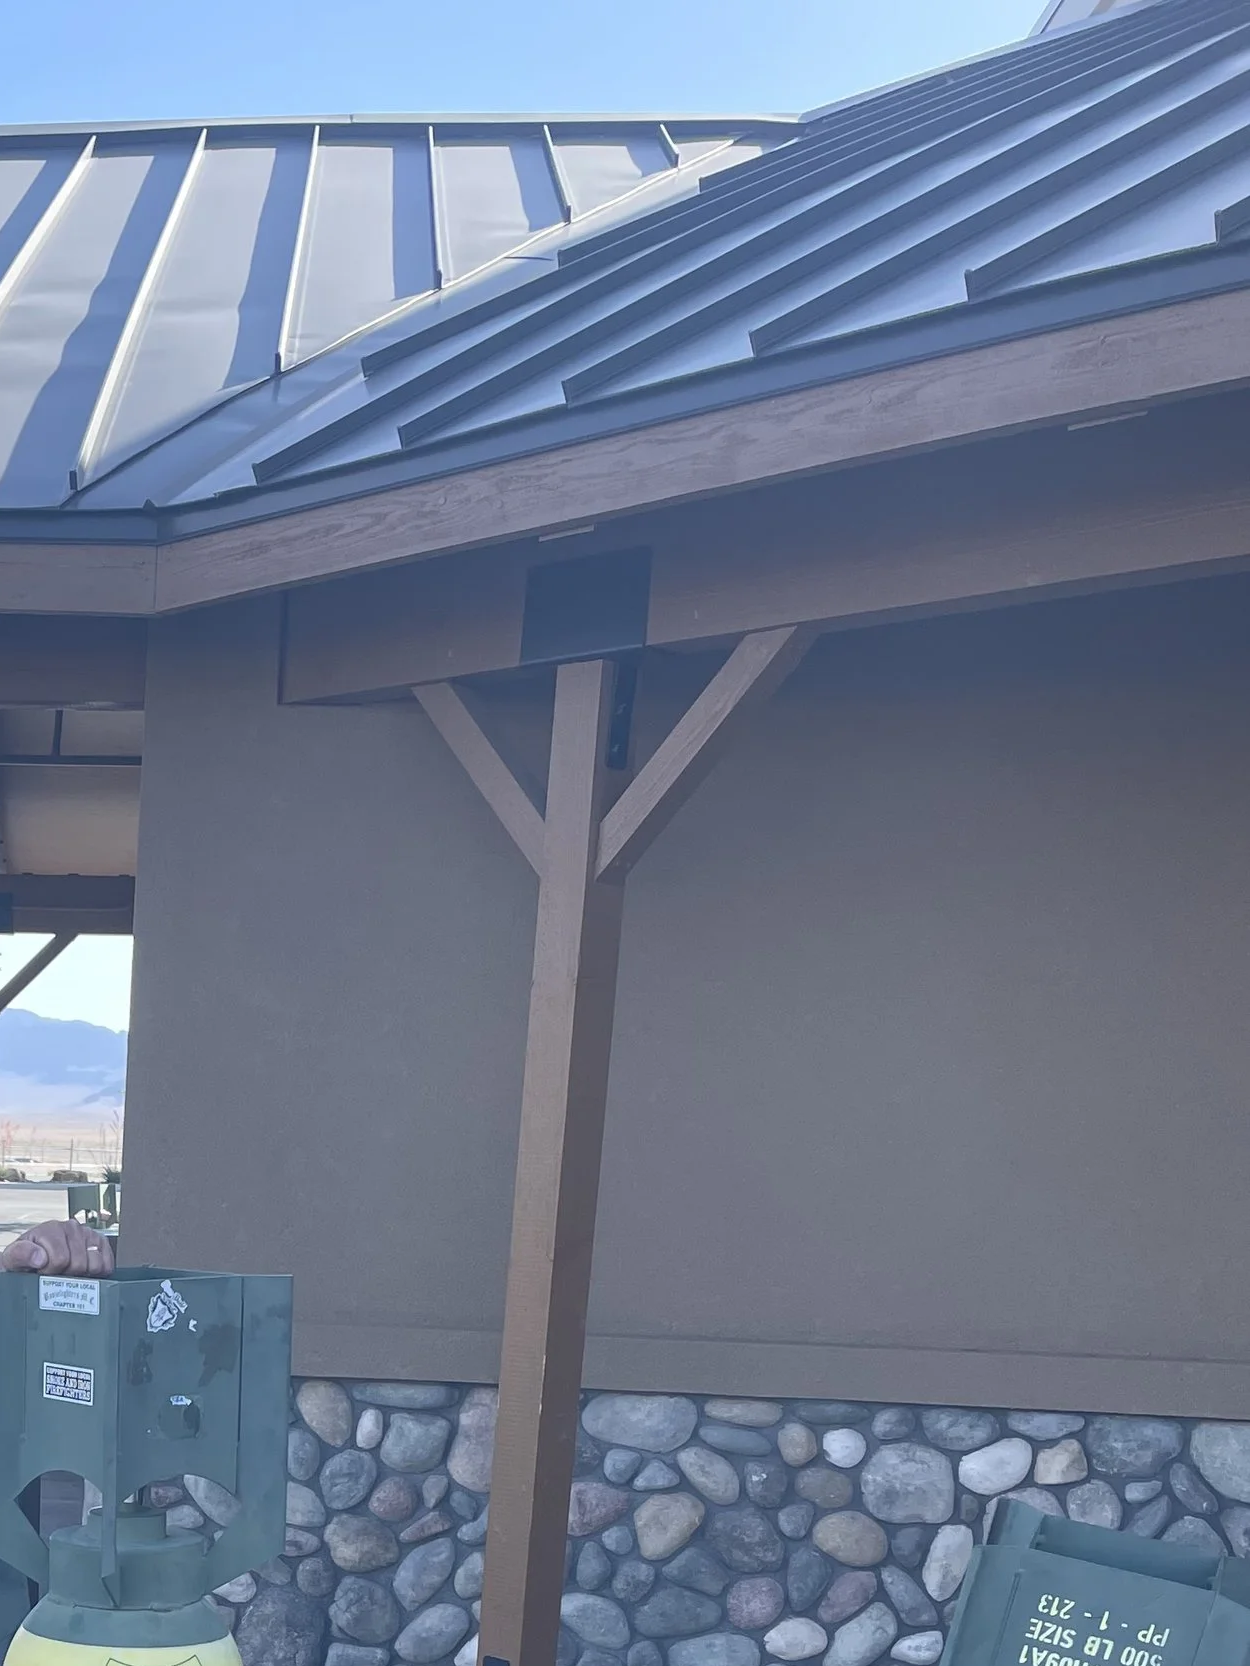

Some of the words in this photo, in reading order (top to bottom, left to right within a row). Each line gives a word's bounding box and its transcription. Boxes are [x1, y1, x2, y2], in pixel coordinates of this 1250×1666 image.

[1037, 1593, 1076, 1620] 213
[1024, 1618, 1077, 1649] SIZE
[1137, 1623, 1170, 1647] PP
[1082, 1635, 1114, 1661] LB
